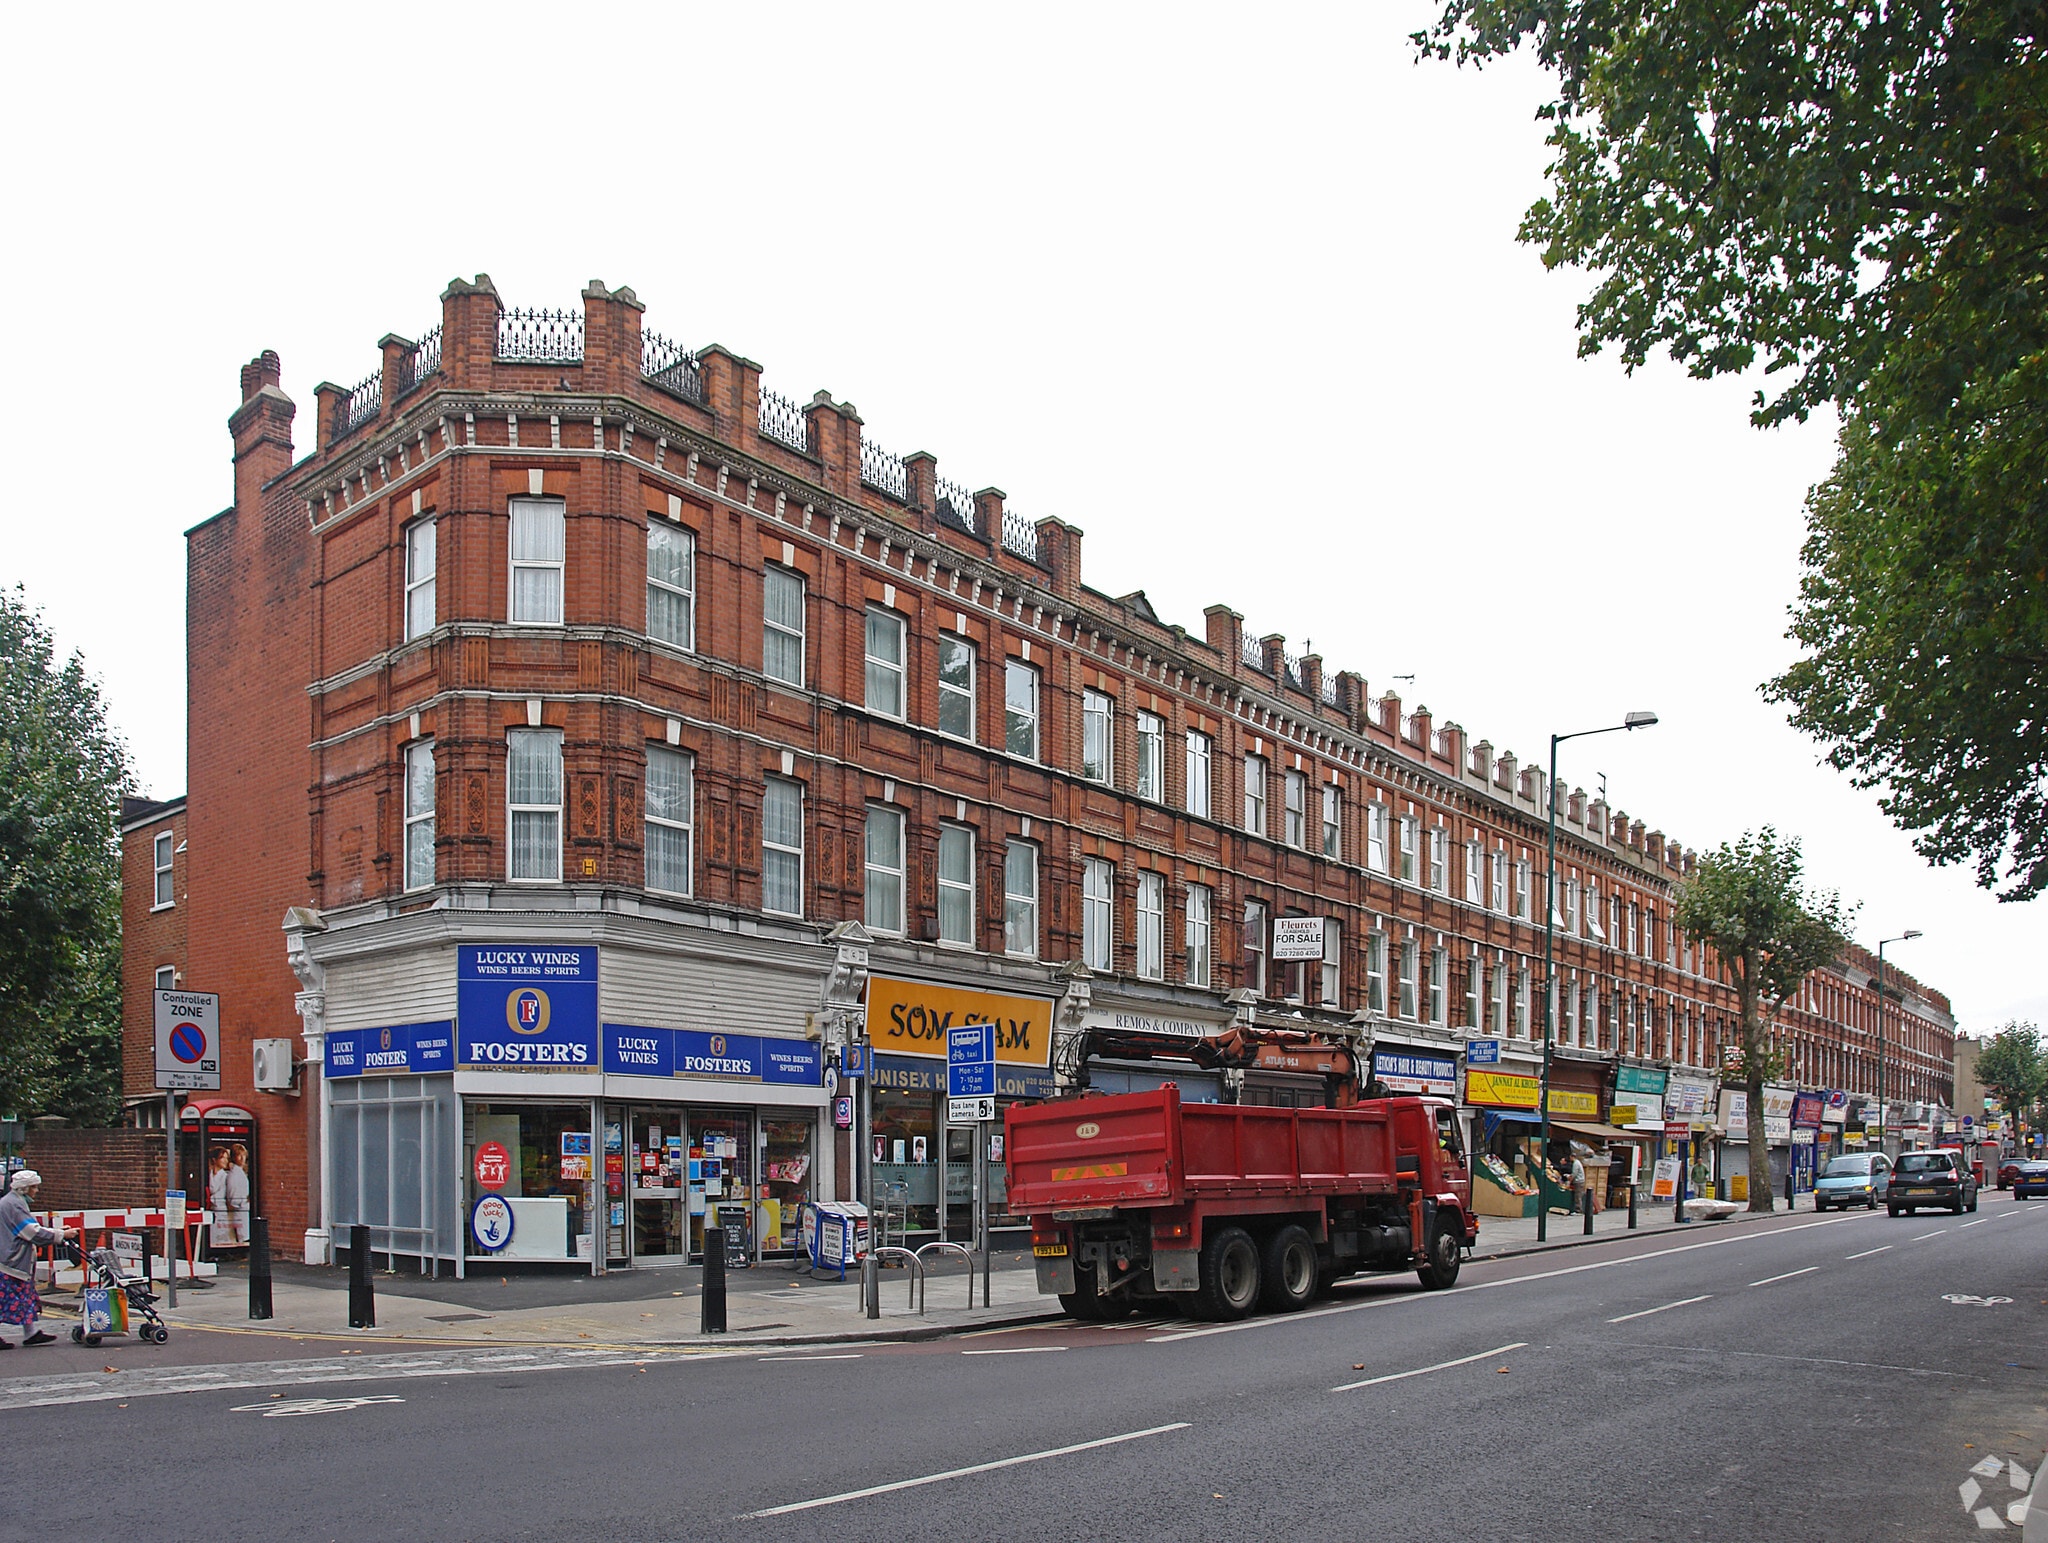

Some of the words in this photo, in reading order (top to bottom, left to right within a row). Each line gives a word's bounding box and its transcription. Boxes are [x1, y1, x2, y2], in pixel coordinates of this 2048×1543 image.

[1281, 921, 1317, 929] Fleurets
[1276, 934, 1295, 943] FOR
[1297, 934, 1321, 943] SALE
[477, 952, 526, 964] LUCKY
[531, 953, 580, 965] WINES
[477, 966, 508, 974] WINES
[511, 966, 541, 974] BEERS
[544, 967, 580, 975] SPIRITS
[162, 993, 212, 1005] Controlled
[171, 1005, 203, 1017] ZONE
[888, 1003, 953, 1040] SOM
[1115, 1014, 1150, 1030] REMOS
[1152, 1020, 1160, 1031] &
[1163, 1020, 1206, 1037] COMPANY
[332, 1041, 354, 1054] LUCKY
[416, 1040, 431, 1049] WINES
[432, 1039, 448, 1048] BEERS
[618, 1037, 658, 1051] LUCKY
[366, 1050, 407, 1066] FOSTER'S
[423, 1050, 441, 1059] SPIRITS
[470, 1042, 587, 1062] FOSTER'S
[618, 1051, 659, 1064] WINES
[333, 1054, 354, 1066] WINES
[685, 1056, 751, 1074] FOSTER'S
[770, 1054, 791, 1064] WINES
[792, 1055, 813, 1064] BEERS
[1265, 1055, 1285, 1065] ATLAS
[202, 1062, 215, 1070] MC
[779, 1064, 804, 1073] SPIRITS
[871, 1069, 930, 1088] UNISEX
[952, 1110, 974, 1118] cameras
[483, 1201, 503, 1210] good
[483, 1209, 504, 1218] luck!
